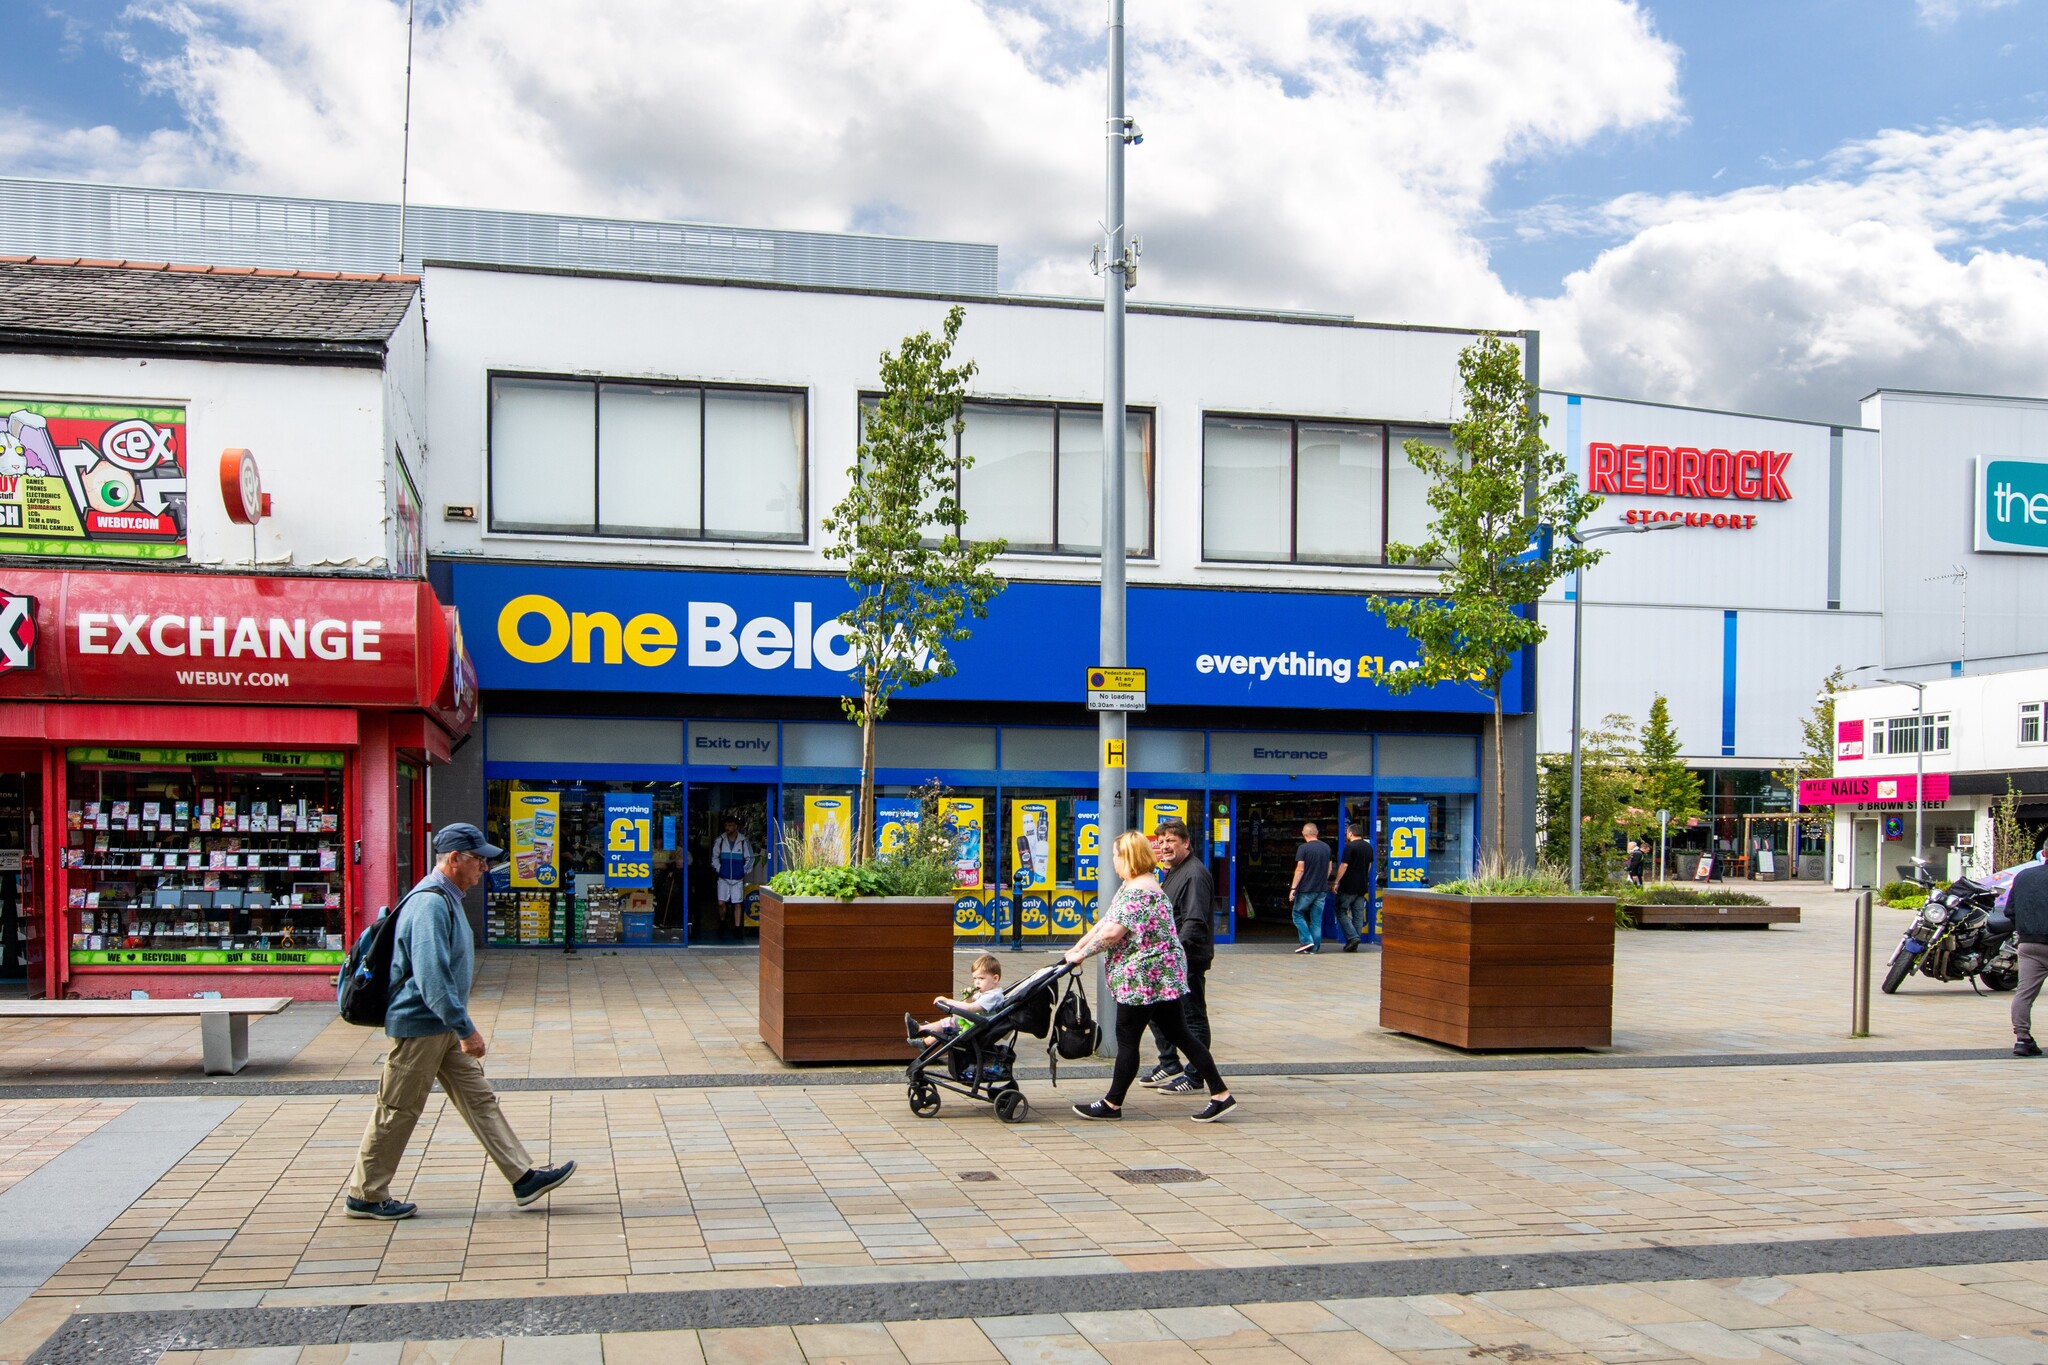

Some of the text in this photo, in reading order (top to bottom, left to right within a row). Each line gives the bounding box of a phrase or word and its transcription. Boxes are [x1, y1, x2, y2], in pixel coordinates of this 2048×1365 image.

[1588, 442, 1793, 499] REDROCK
[1994, 482, 2048, 524] the
[97, 516, 159, 530] WEBUY.COM
[78, 613, 382, 661] EXCHANGE
[498, 594, 678, 667] One
[1196, 651, 1352, 683] everything
[176, 671, 289, 687] WEBUY.COM
[696, 736, 771, 752] Exit only
[107, 750, 300, 765] GAMING PHONES FILM & TV
[1253, 748, 1328, 760] Entrance
[1114, 791, 1121, 799] 4
[1831, 780, 1869, 795] NAILS
[608, 806, 649, 814] everything
[1858, 801, 1863, 810] 8
[1867, 801, 1903, 810] BROWN
[608, 818, 650, 852] £1
[1390, 826, 1426, 858] £1
[538, 872, 555, 882] 49p
[608, 863, 650, 878] LESS
[1390, 868, 1424, 882] LESS
[958, 900, 977, 908] only
[1022, 899, 1041, 908] only
[1057, 899, 1076, 908] only
[956, 908, 983, 924] 89p
[1022, 908, 1047, 923] 69p
[1055, 908, 1081, 923] 79p
[107, 952, 186, 962] WE RECYCLING
[227, 953, 306, 962] BUY SELL DONATE
